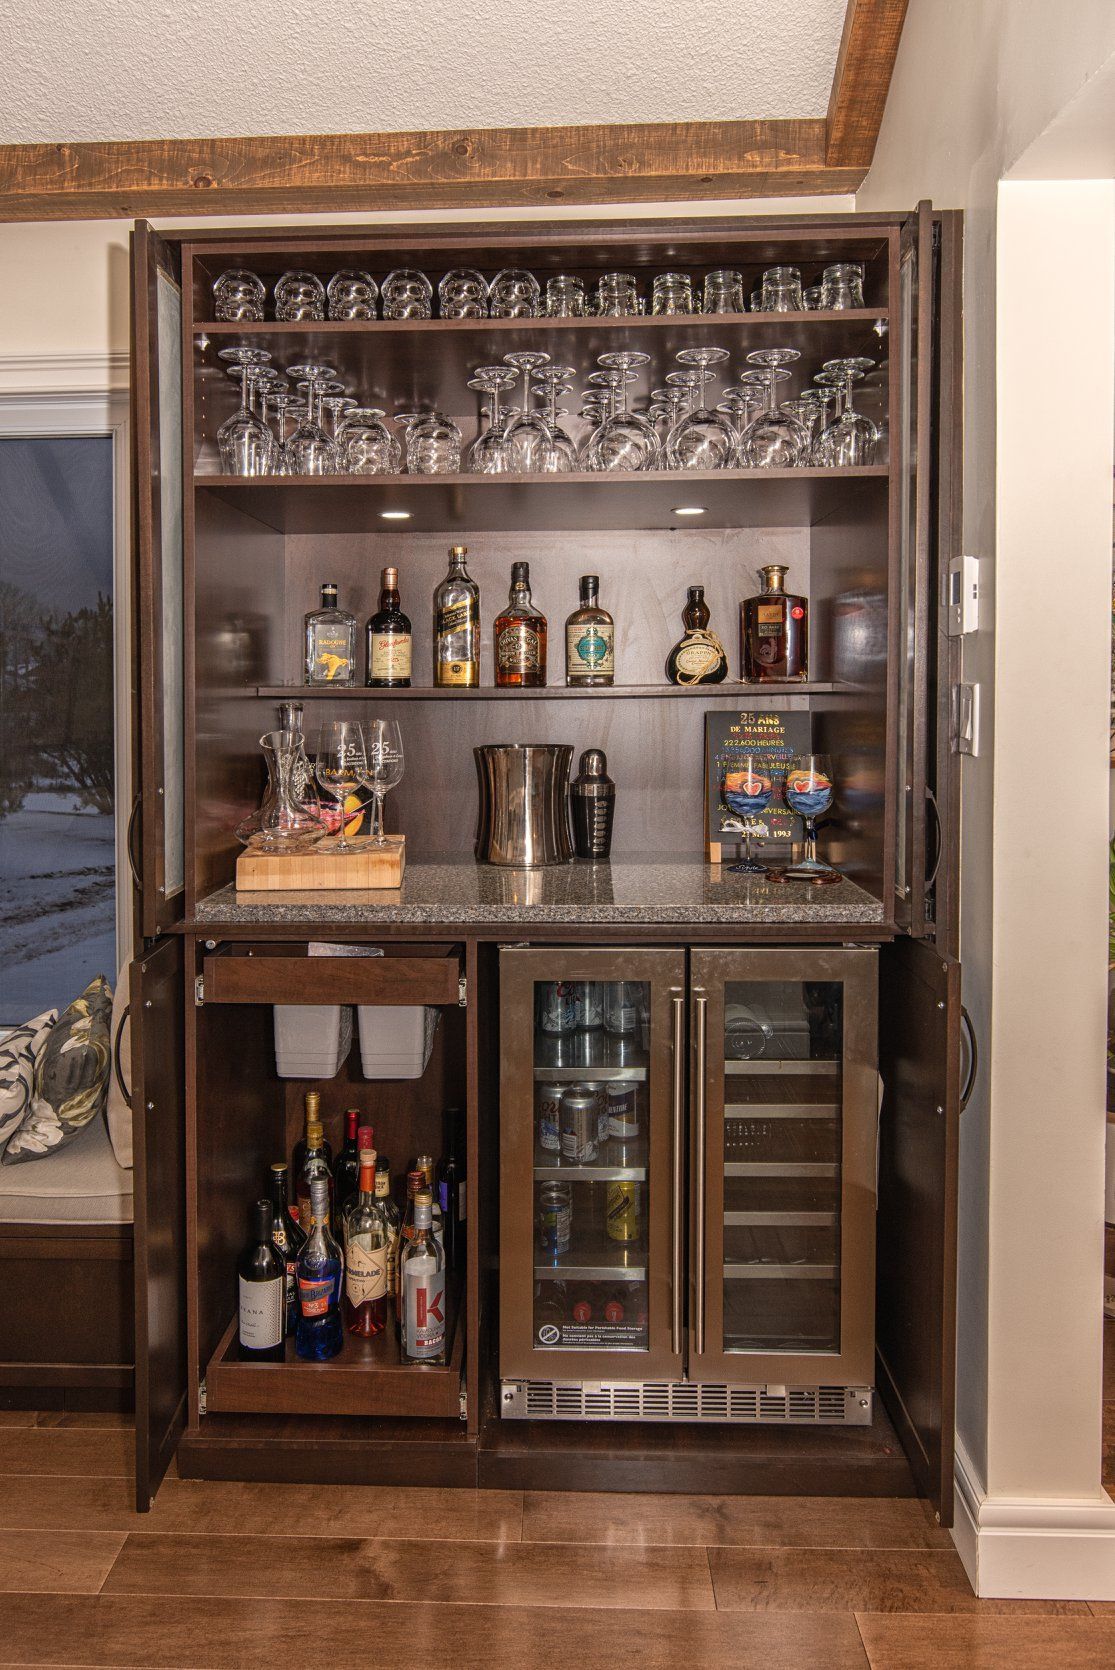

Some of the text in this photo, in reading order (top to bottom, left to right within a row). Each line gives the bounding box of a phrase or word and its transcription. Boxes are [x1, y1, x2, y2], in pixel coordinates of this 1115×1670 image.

[740, 712, 756, 725] 25
[729, 726, 786, 735] DE MARIAGE
[371, 742, 390, 755] 25
[756, 739, 785, 748] HEURES
[337, 744, 356, 757] 25
[772, 830, 792, 839] 1993
